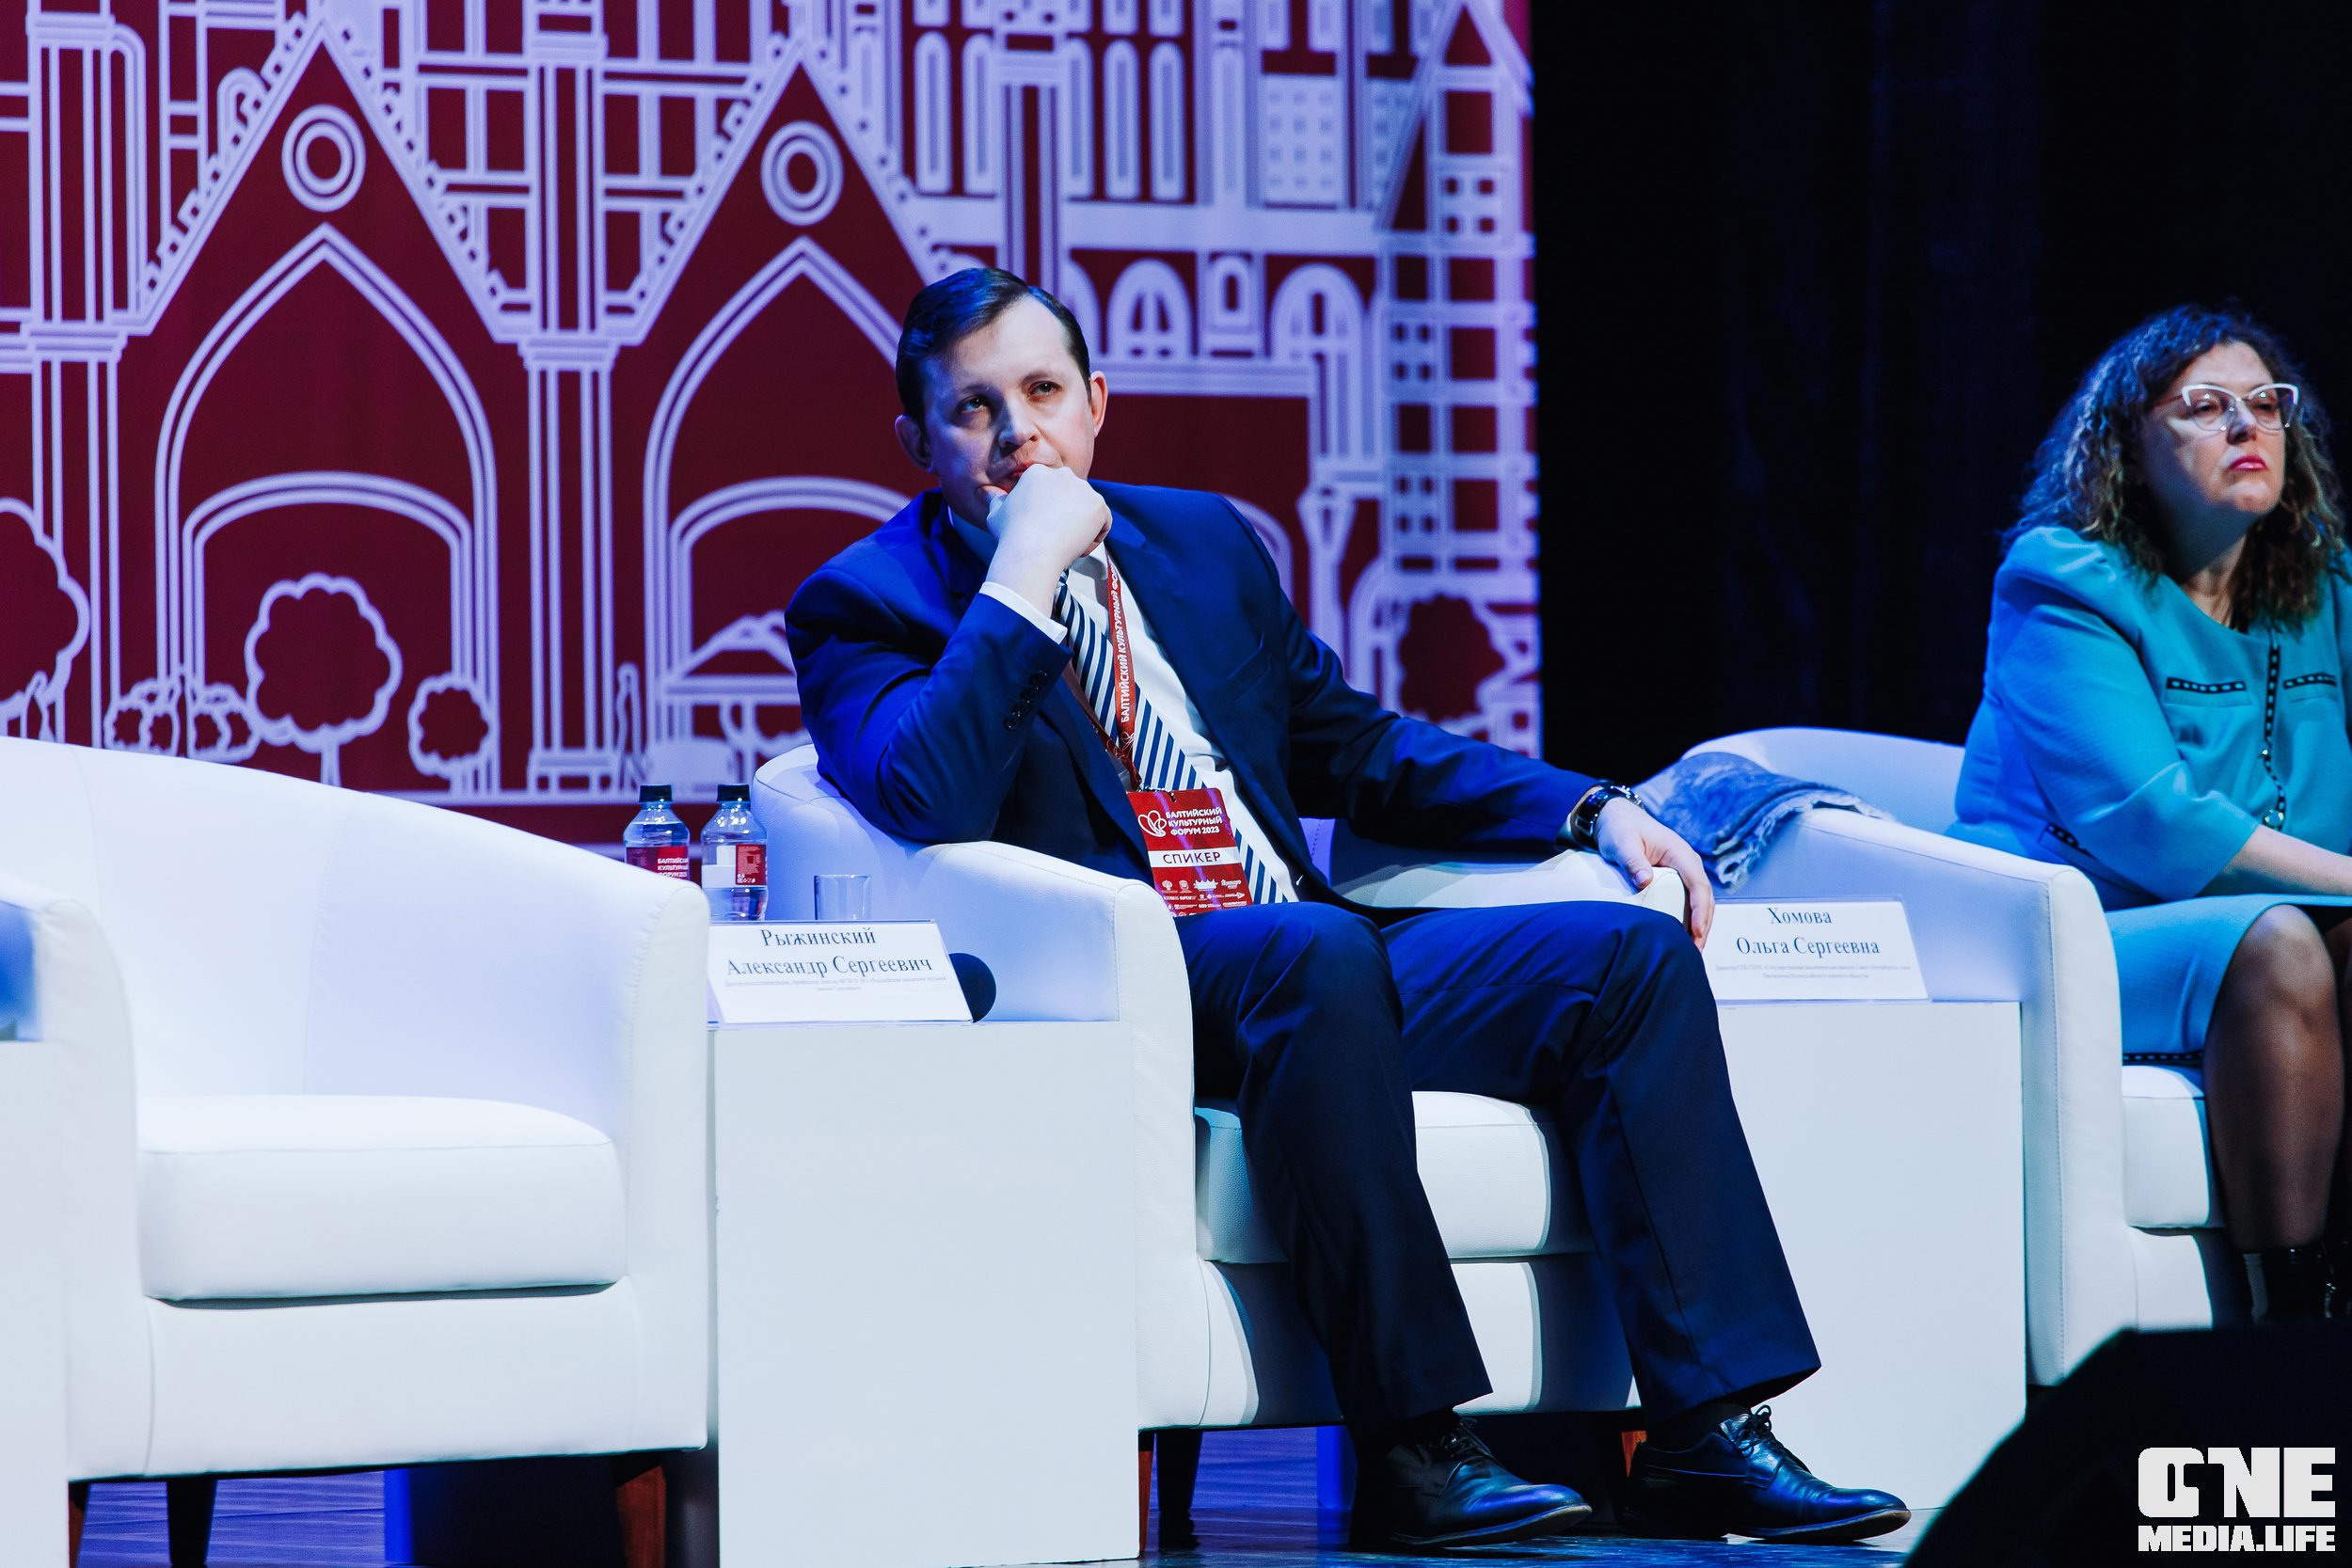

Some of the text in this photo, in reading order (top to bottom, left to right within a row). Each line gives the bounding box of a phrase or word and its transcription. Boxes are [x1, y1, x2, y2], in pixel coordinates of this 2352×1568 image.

[1111, 591, 1127, 653] КУЛЬТУРНЫЙ
[1118, 656, 1130, 722] БАЛТИЙСКИЙ
[1166, 807, 1222, 818] БАЛТИЙСКИЙ
[1168, 816, 1222, 827] КУЛЬТУРНЫЙ
[1170, 826, 1220, 836] ФОРУМ 2023
[1163, 851, 1221, 864] СПИКЕР
[1766, 907, 1833, 924] Хомова
[760, 927, 876, 947] Рыжинский
[1736, 936, 1880, 958] Ольга Сергеевна
[726, 955, 933, 978] Александр Сергеевич
